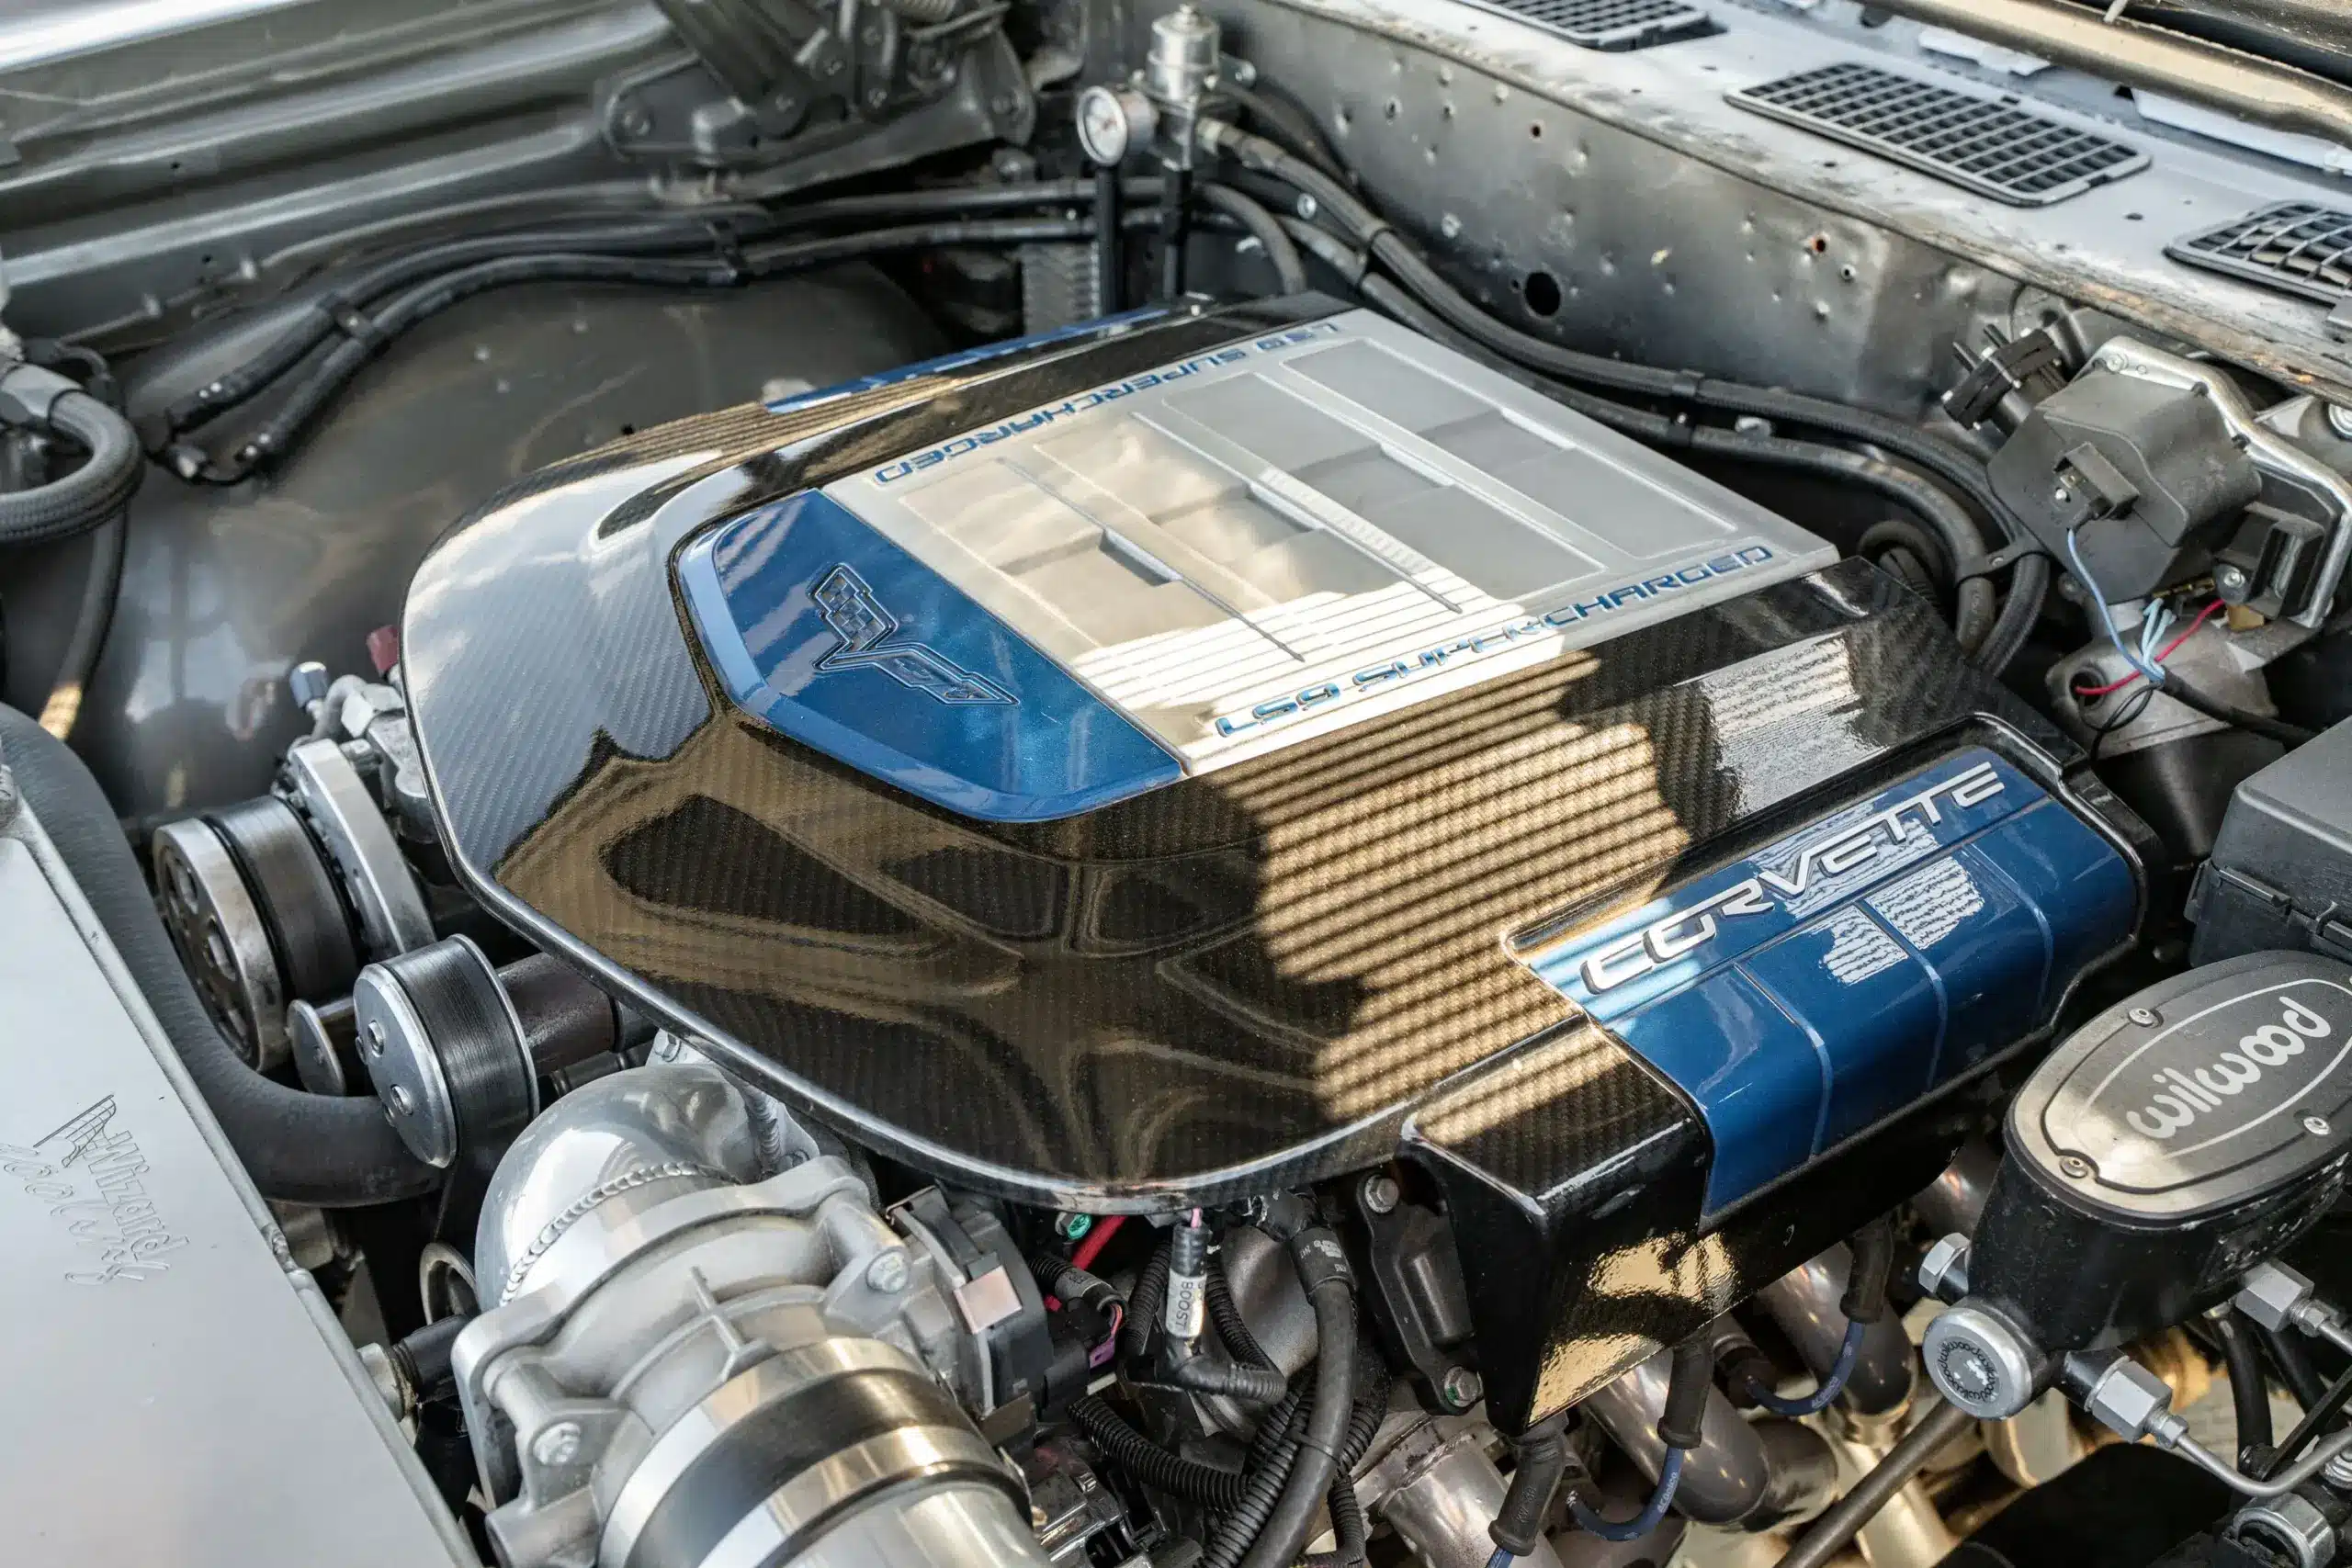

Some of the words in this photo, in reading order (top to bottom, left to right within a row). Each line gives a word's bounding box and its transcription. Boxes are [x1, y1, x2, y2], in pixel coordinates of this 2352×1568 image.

[874, 348, 1247, 484] SUPERCHARGED
[1215, 682, 1340, 739] LS9
[1579, 761, 2006, 995] CORVETTE
[2125, 996, 2332, 1139] wilwood
[1175, 1281, 1194, 1331] BOOST
